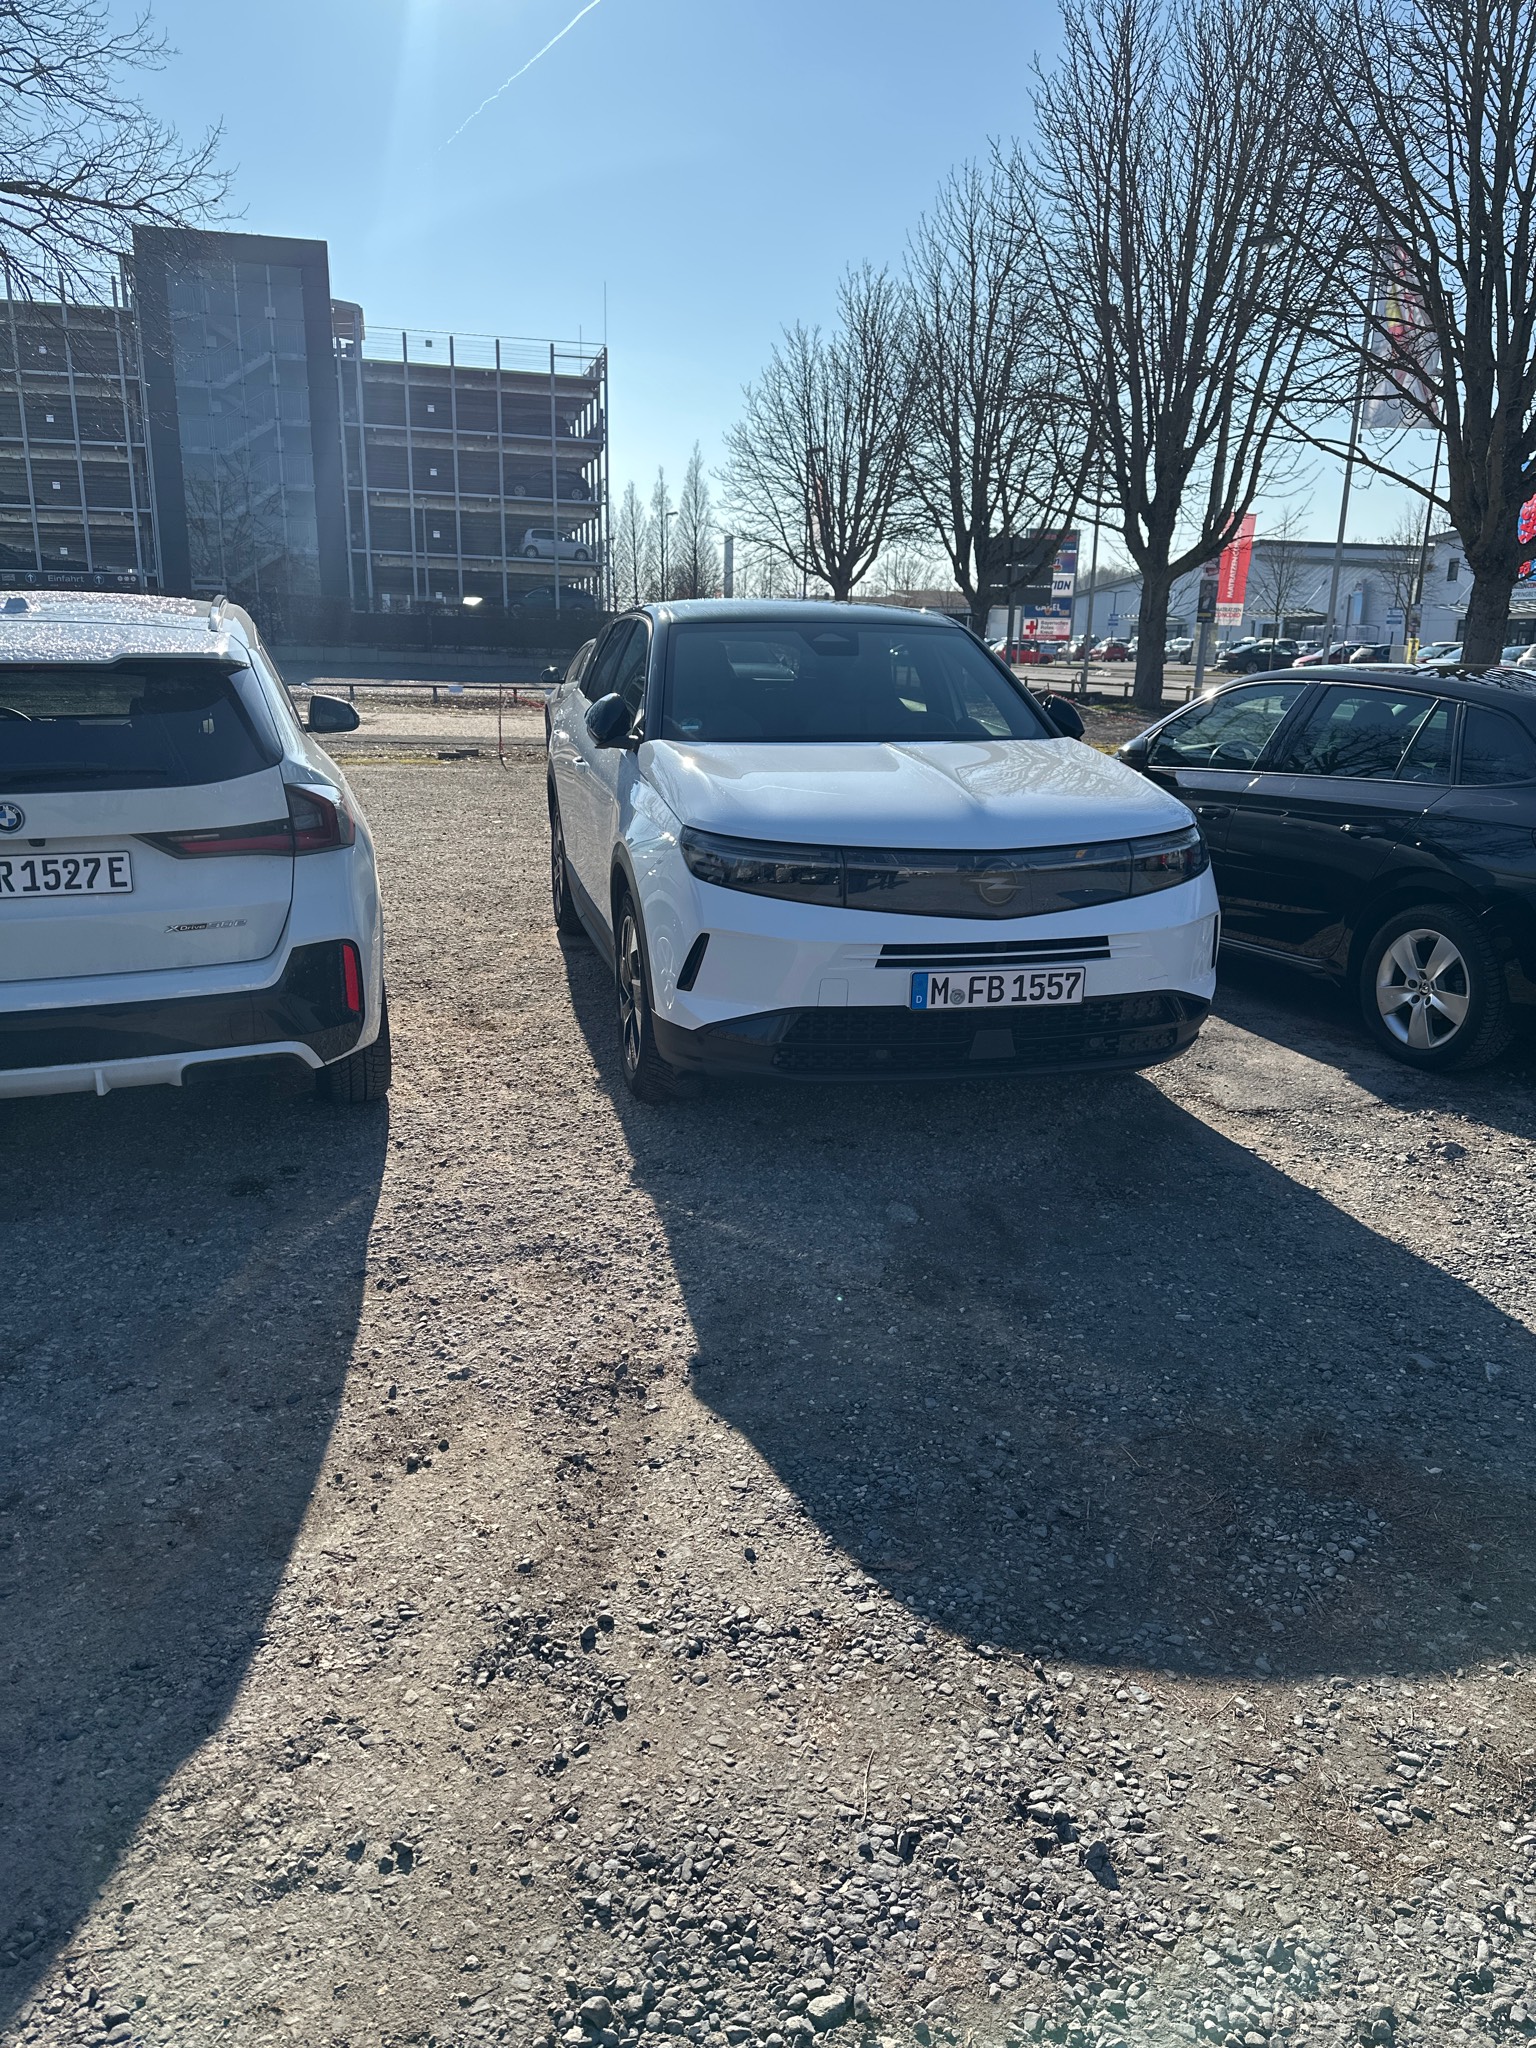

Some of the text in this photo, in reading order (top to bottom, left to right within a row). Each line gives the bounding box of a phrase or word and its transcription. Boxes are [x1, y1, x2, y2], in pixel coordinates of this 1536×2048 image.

[47, 574, 85, 583] Einfahrt
[930, 972, 1082, 1005] M FB 1557
[916, 995, 922, 1004] D
